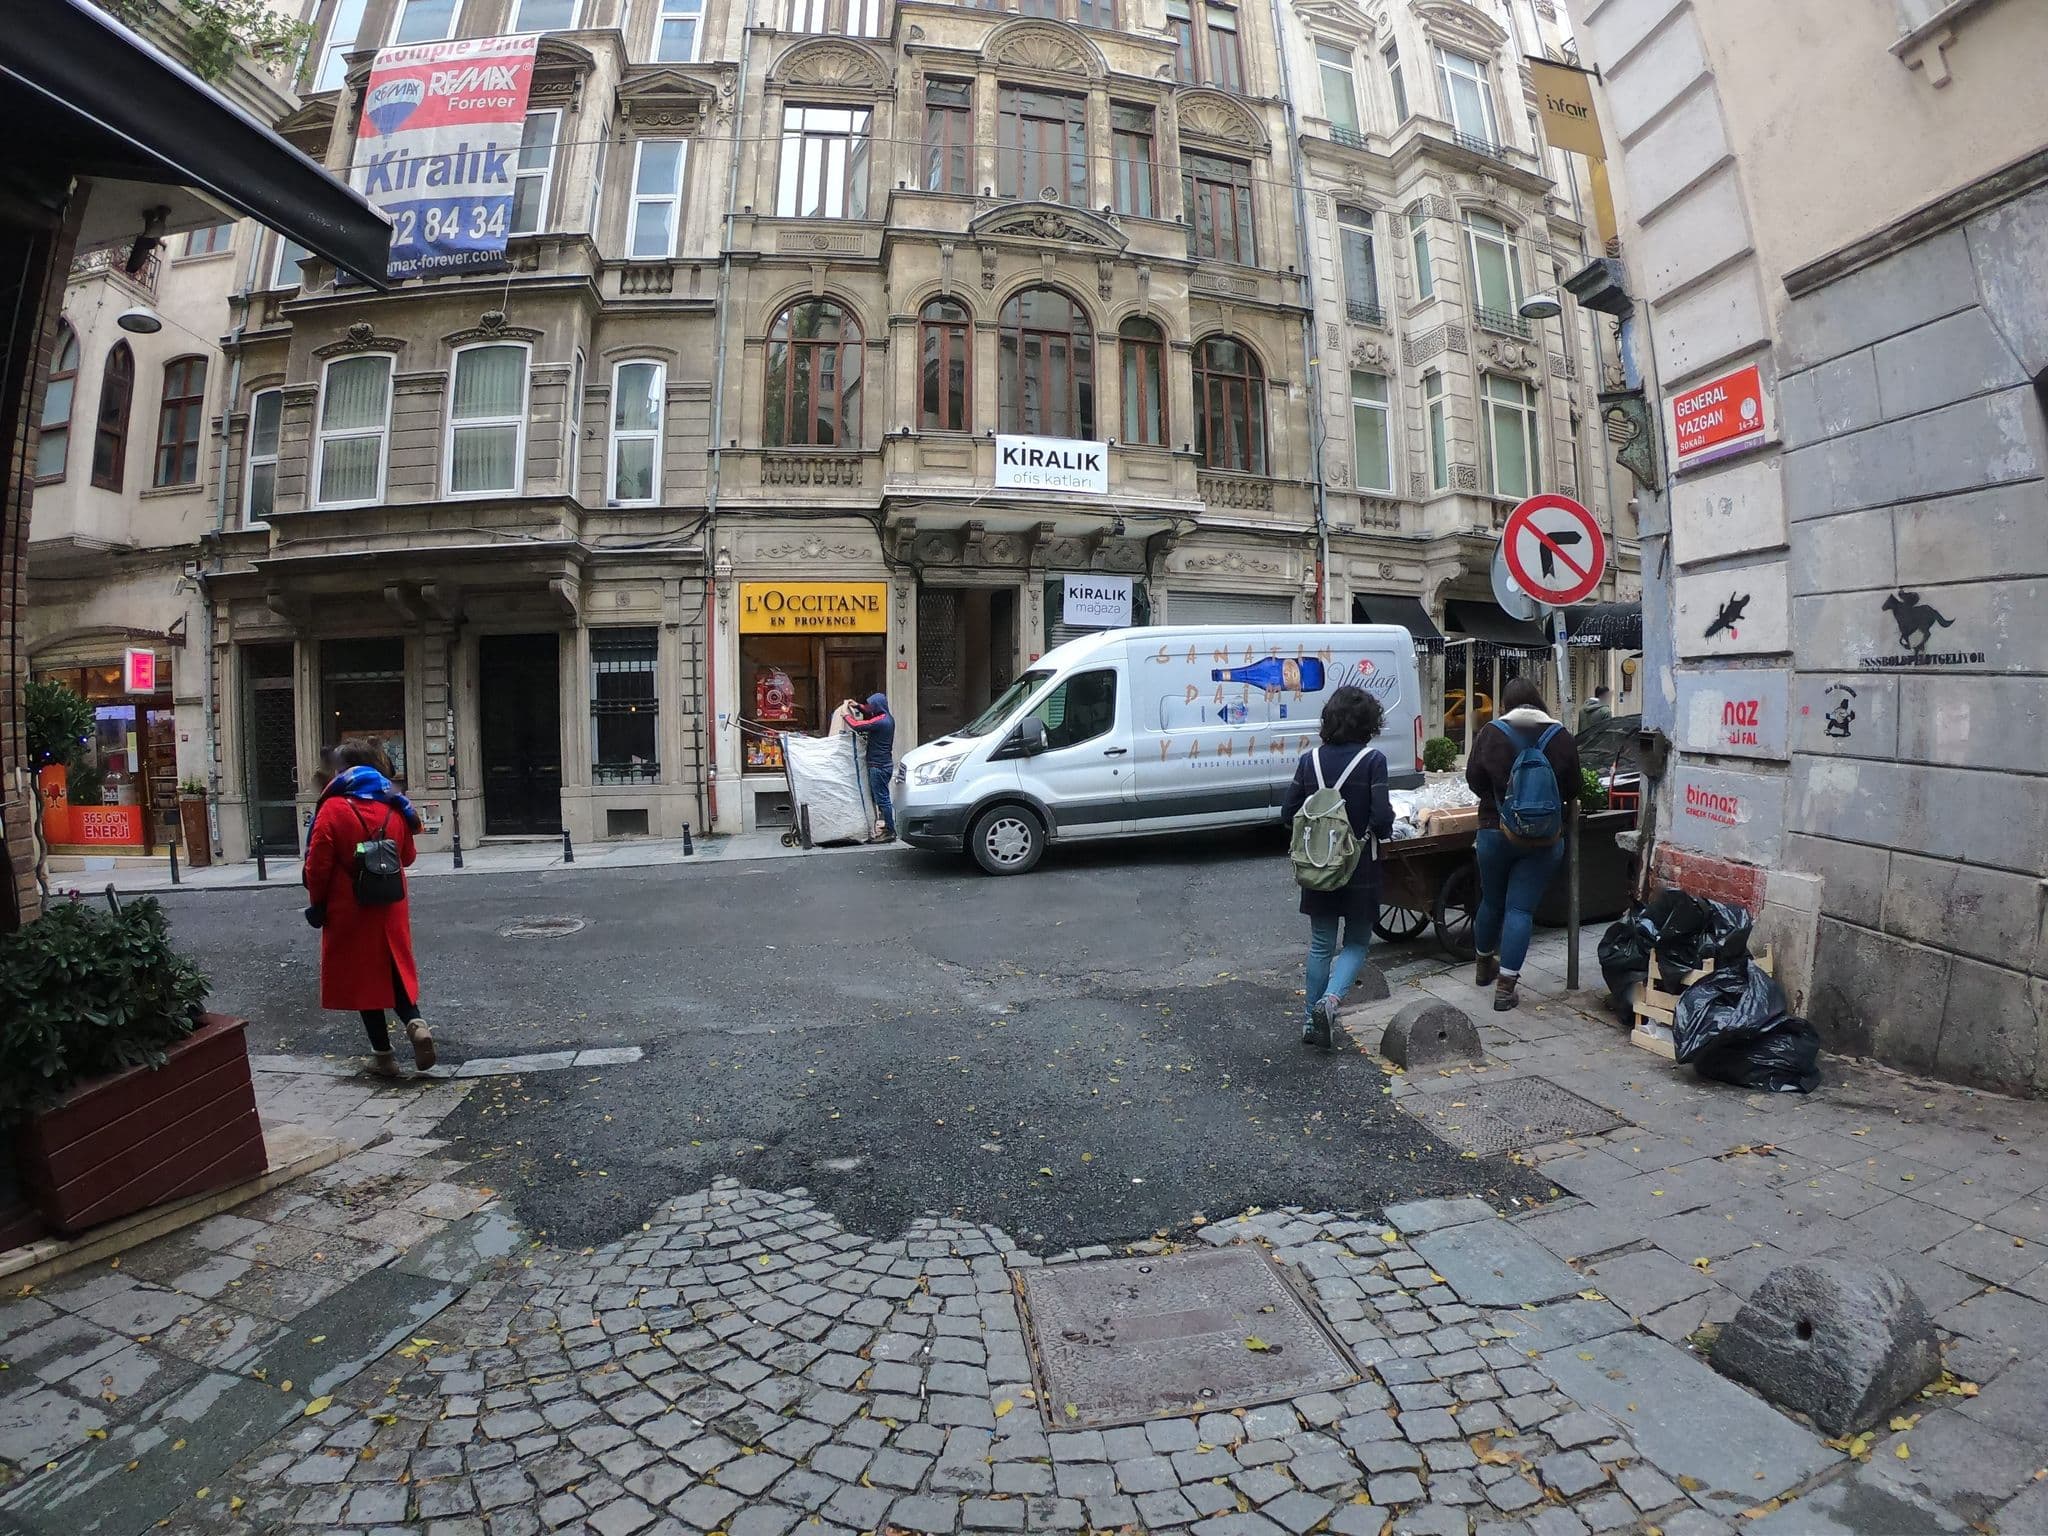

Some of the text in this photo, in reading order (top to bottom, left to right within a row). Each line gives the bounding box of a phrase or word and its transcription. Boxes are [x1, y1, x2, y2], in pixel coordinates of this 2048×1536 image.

[447, 96, 516, 112] Forever
[1546, 94, 1588, 118] infair
[424, 206, 460, 243] 84
[469, 203, 505, 239] 34
[1677, 386, 1728, 417] GENERAL
[1678, 409, 1724, 437] YAZGAN
[1003, 441, 1100, 471] KİRALIK
[1013, 471, 1093, 487] ofis katları
[746, 590, 880, 612] L'OCCITANE
[1070, 583, 1127, 601] KİRALIK
[1076, 601, 1121, 616] mağaza
[771, 616, 857, 626] EN PROVENCE
[1328, 661, 1397, 699] Uludağ
[1742, 732, 1758, 745] FAL
[1687, 784, 1738, 815] binnaz
[84, 812, 102, 824] 365
